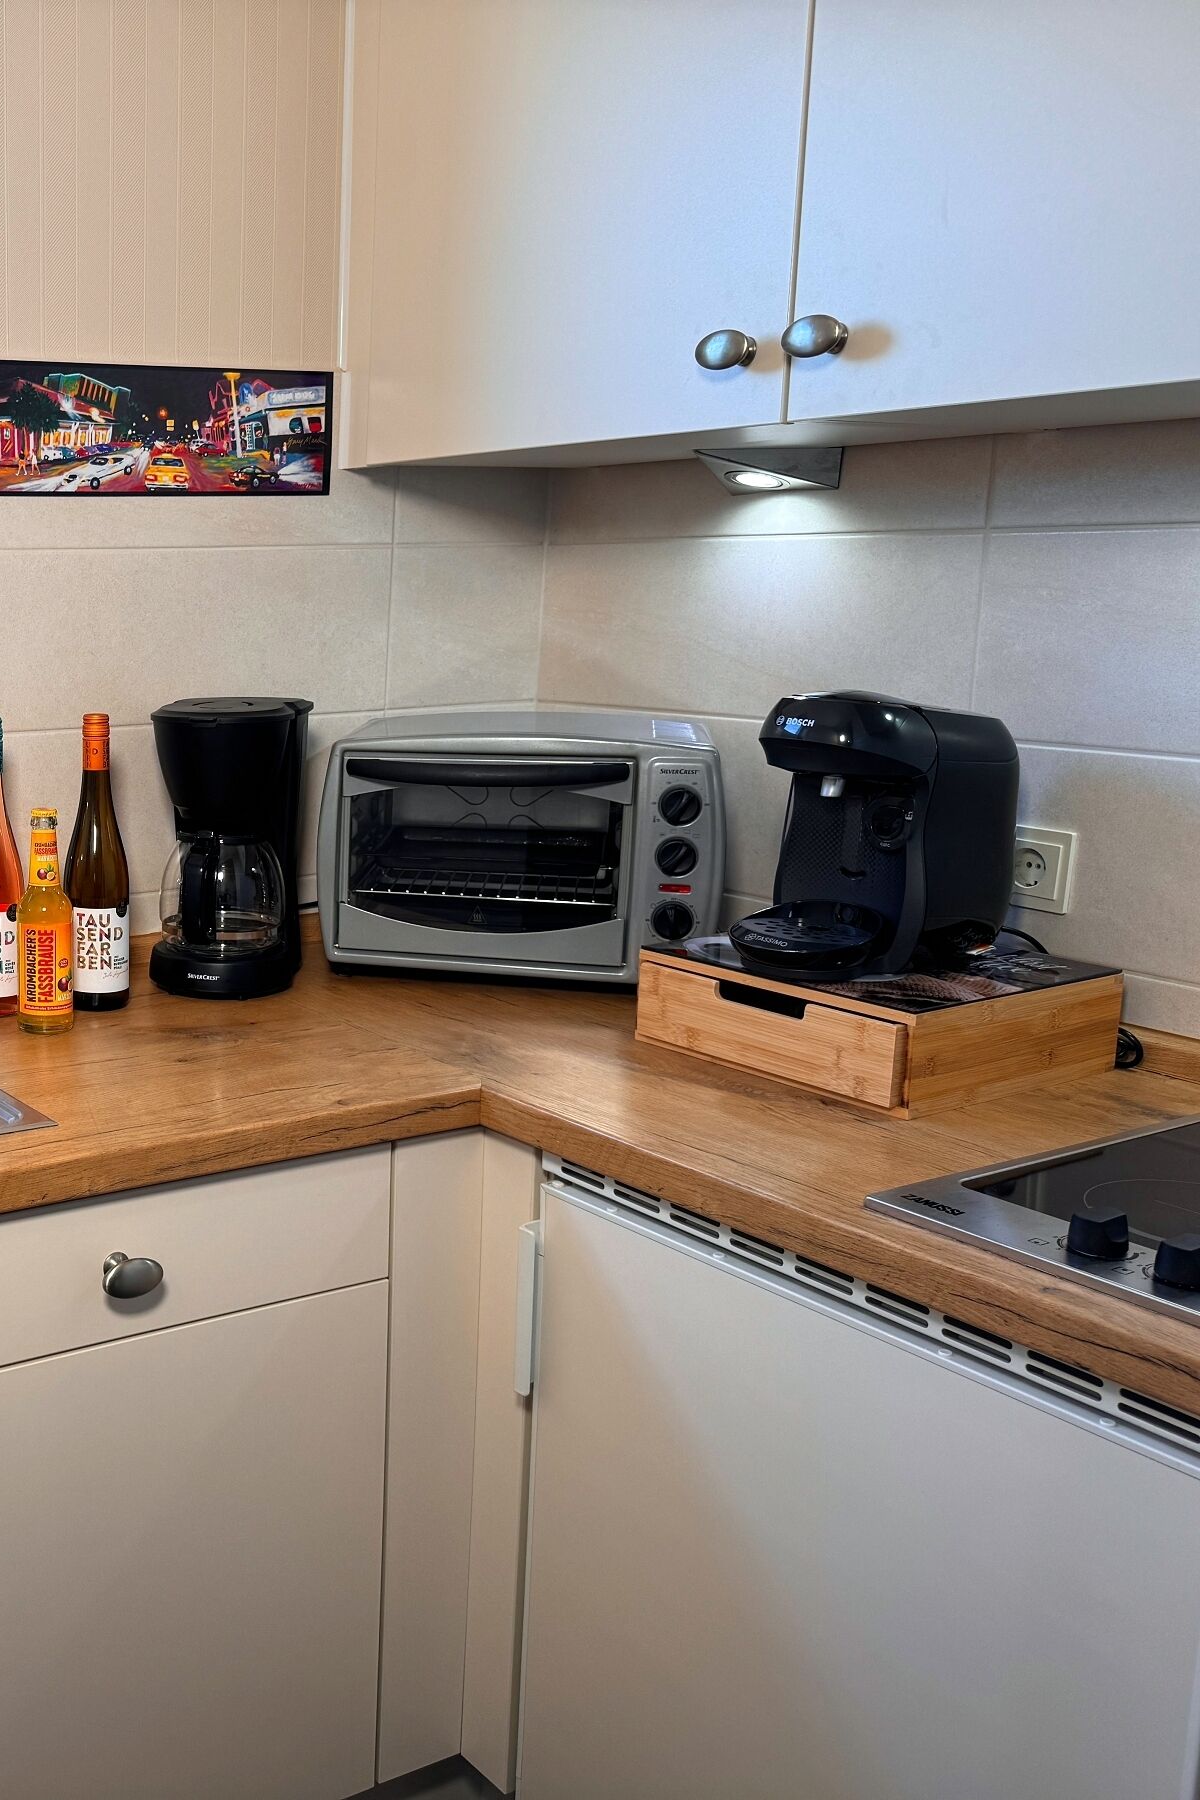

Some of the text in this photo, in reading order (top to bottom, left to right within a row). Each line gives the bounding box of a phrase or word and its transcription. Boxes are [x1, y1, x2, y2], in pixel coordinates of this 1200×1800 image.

[785, 717, 815, 727] BOSCH
[76, 912, 111, 928] TAU
[76, 926, 124, 942] SEND
[755, 935, 788, 947] TASSIMO
[77, 941, 111, 956] FAR
[38, 929, 54, 1003] FASSBRAUSE
[77, 955, 112, 970] BEN
[900, 1193, 966, 1217] ZANUSSI
